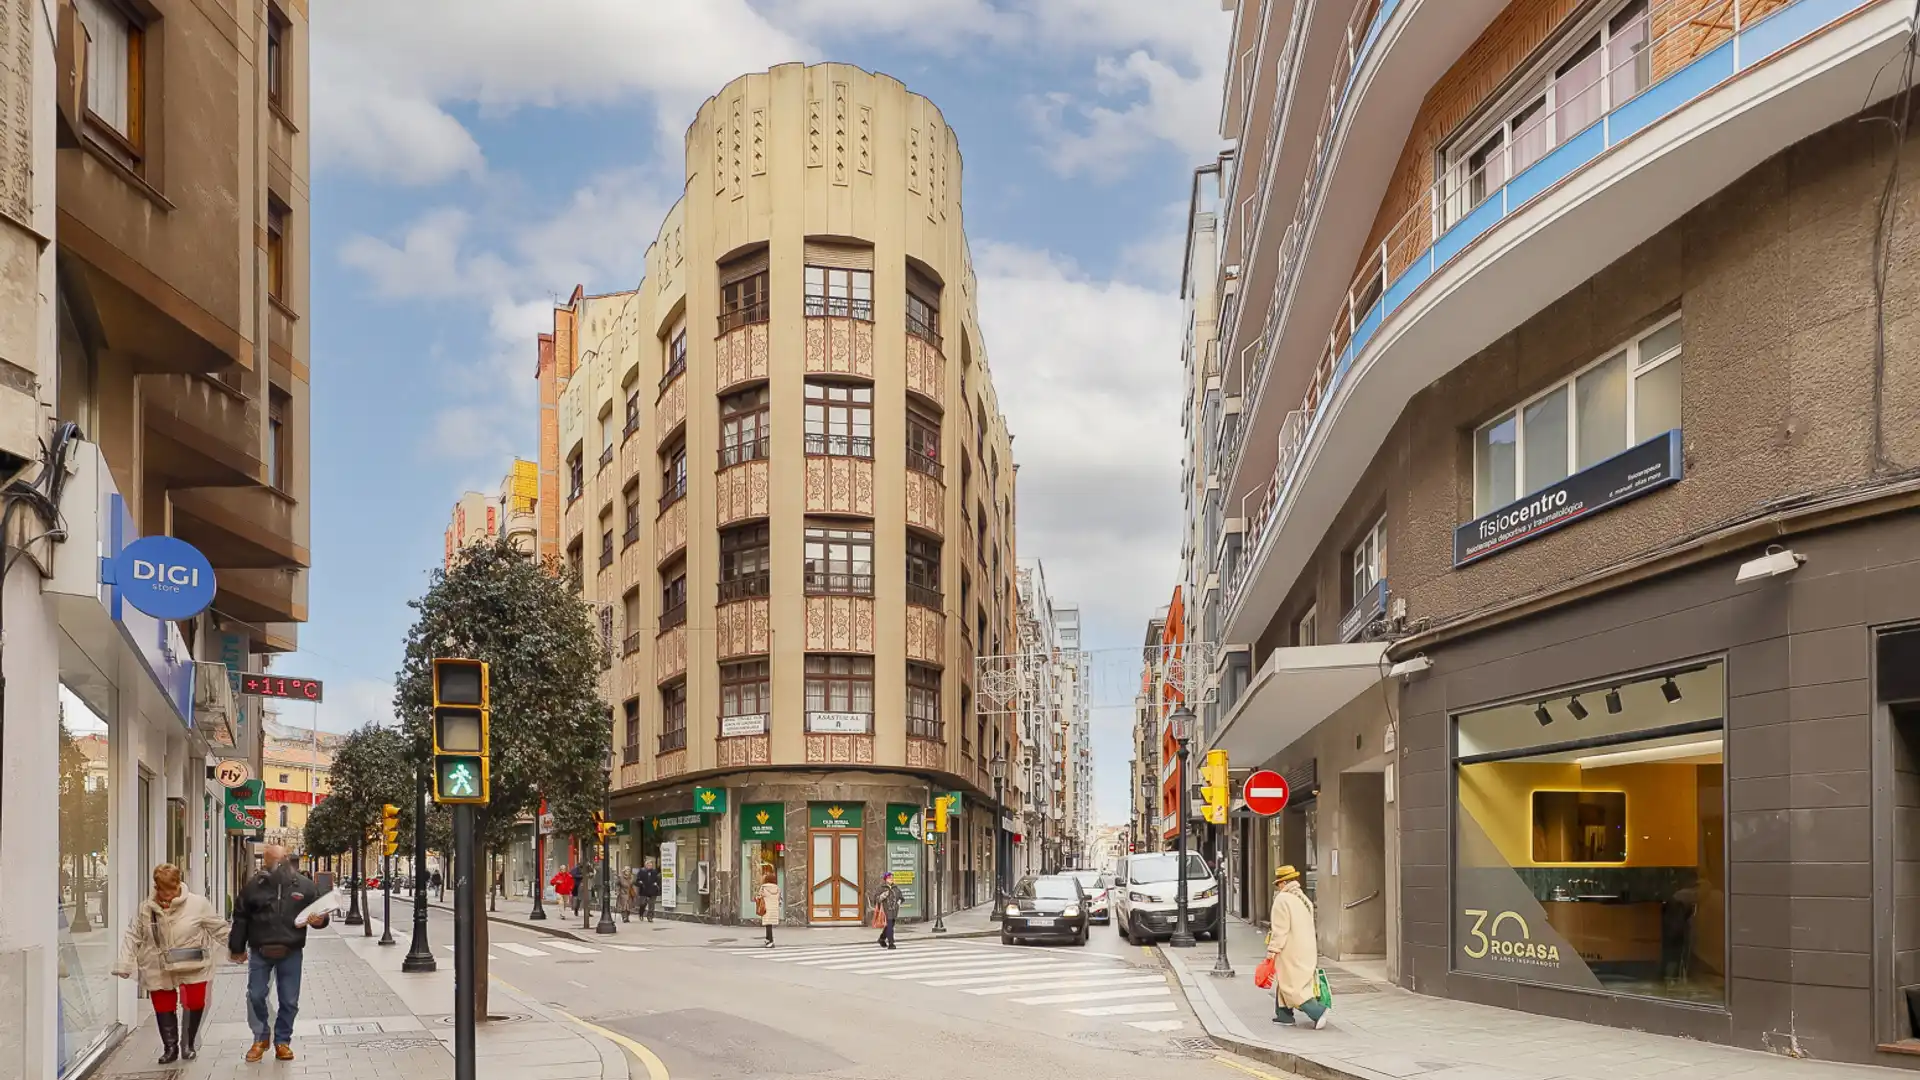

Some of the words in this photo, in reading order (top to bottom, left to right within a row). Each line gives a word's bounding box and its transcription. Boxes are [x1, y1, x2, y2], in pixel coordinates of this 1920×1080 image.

[1478, 489, 1568, 540] fisiocentro
[1465, 536, 1499, 556] fisioterapia
[1497, 524, 1528, 544] deportiva
[1533, 501, 1584, 528] traumatológica
[133, 559, 199, 587] DIGI
[152, 583, 180, 594] store
[220, 769, 241, 782] Fly
[1491, 940, 1560, 961] ROCASA
